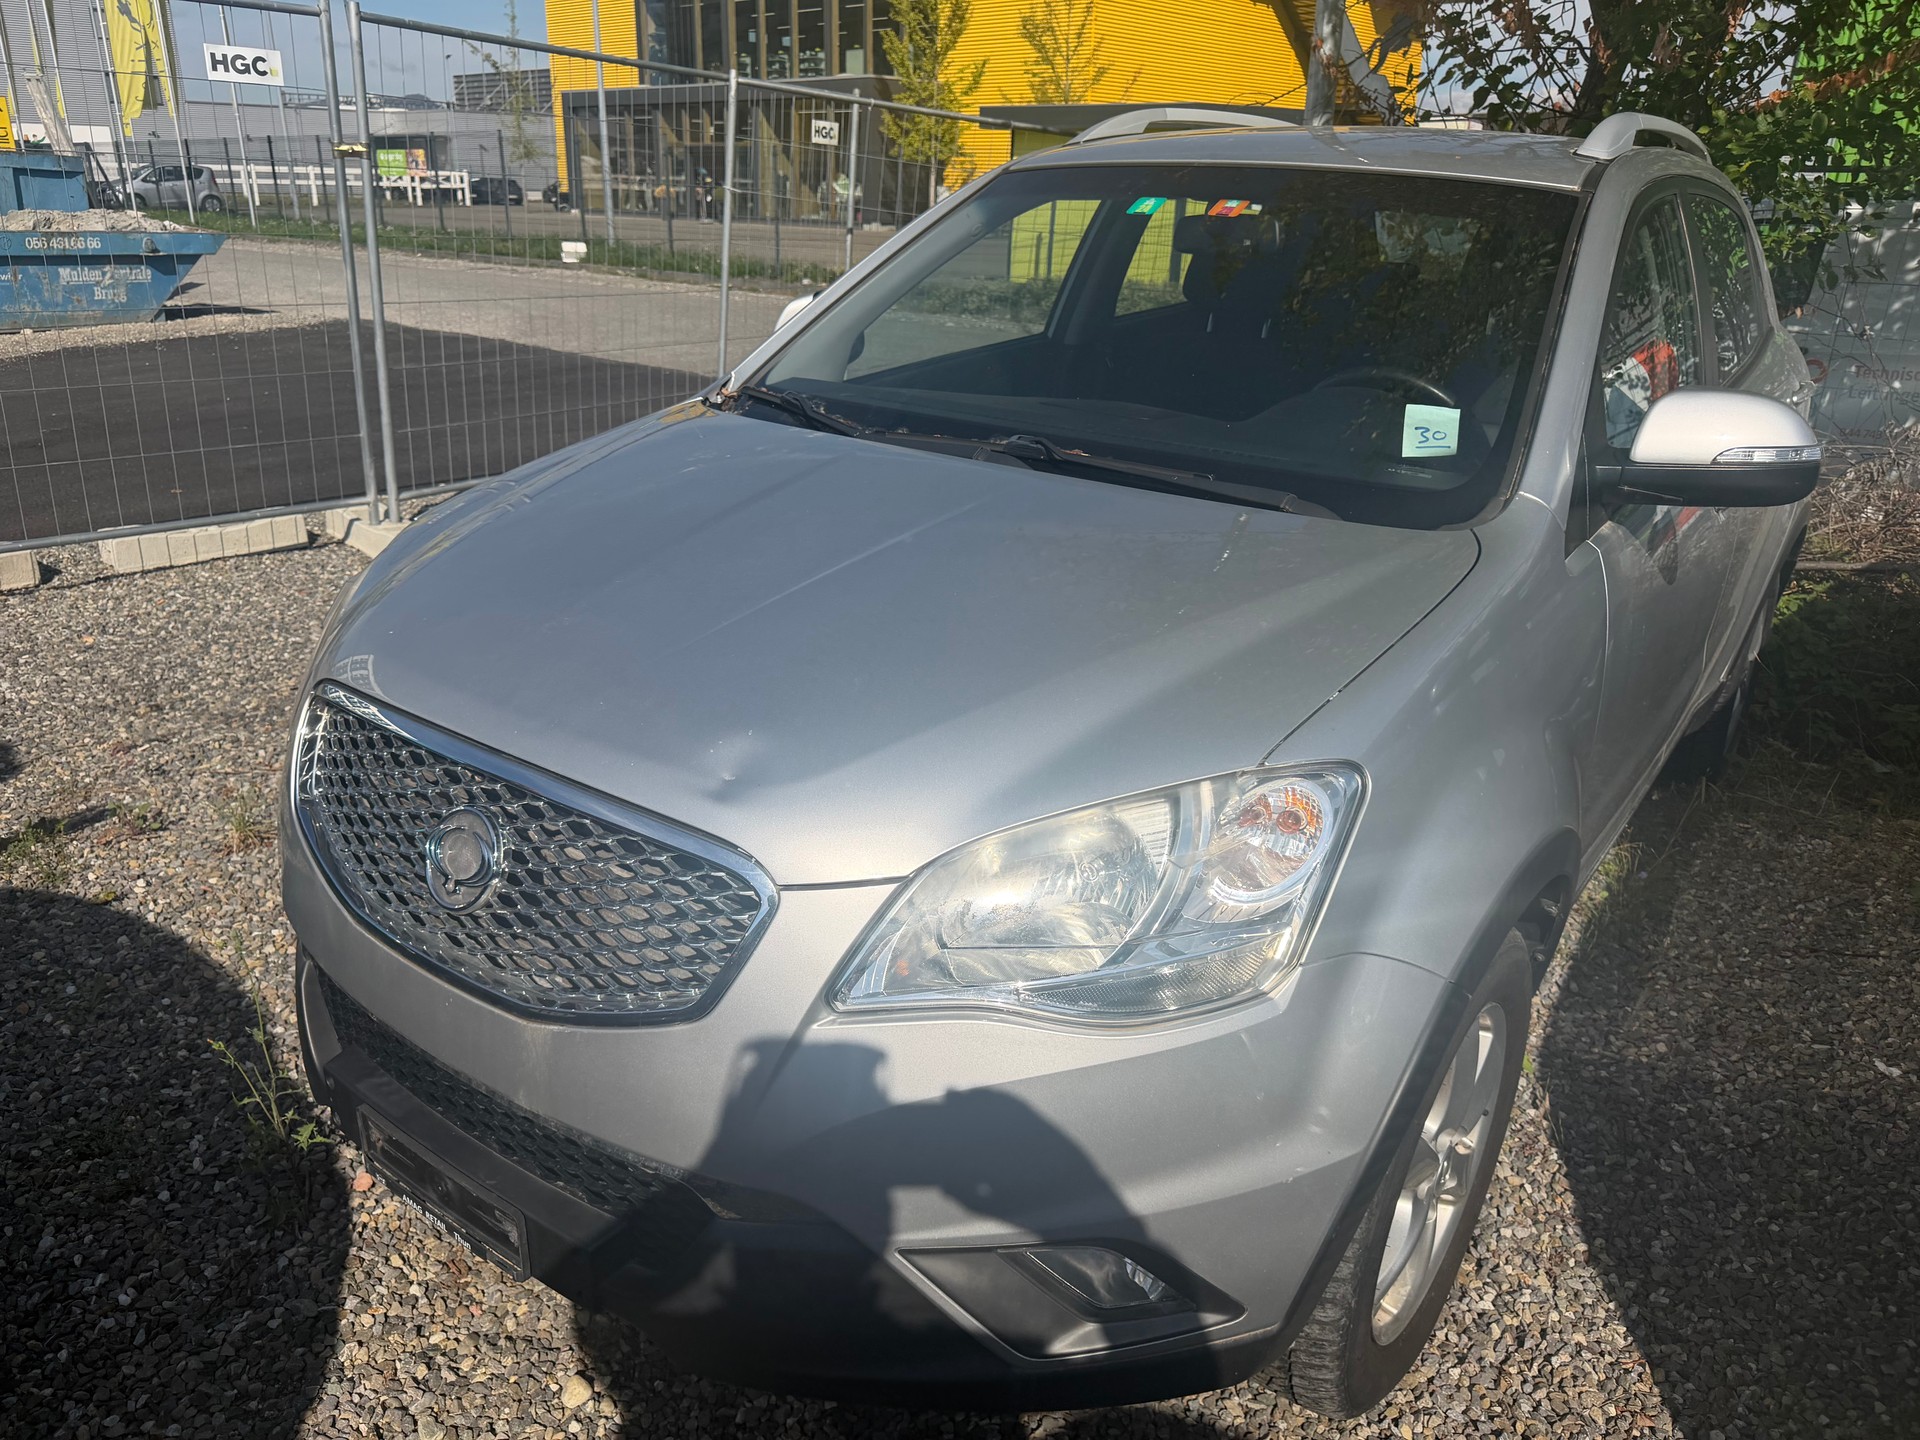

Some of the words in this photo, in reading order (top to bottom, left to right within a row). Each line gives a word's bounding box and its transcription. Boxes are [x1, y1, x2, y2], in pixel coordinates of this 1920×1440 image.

[87, 237, 102, 249] 66
[1414, 426, 1447, 444] 30
[402, 1194, 423, 1214] AMAG
[425, 1210, 448, 1233] RETAIL
[453, 1231, 472, 1250] Thun
